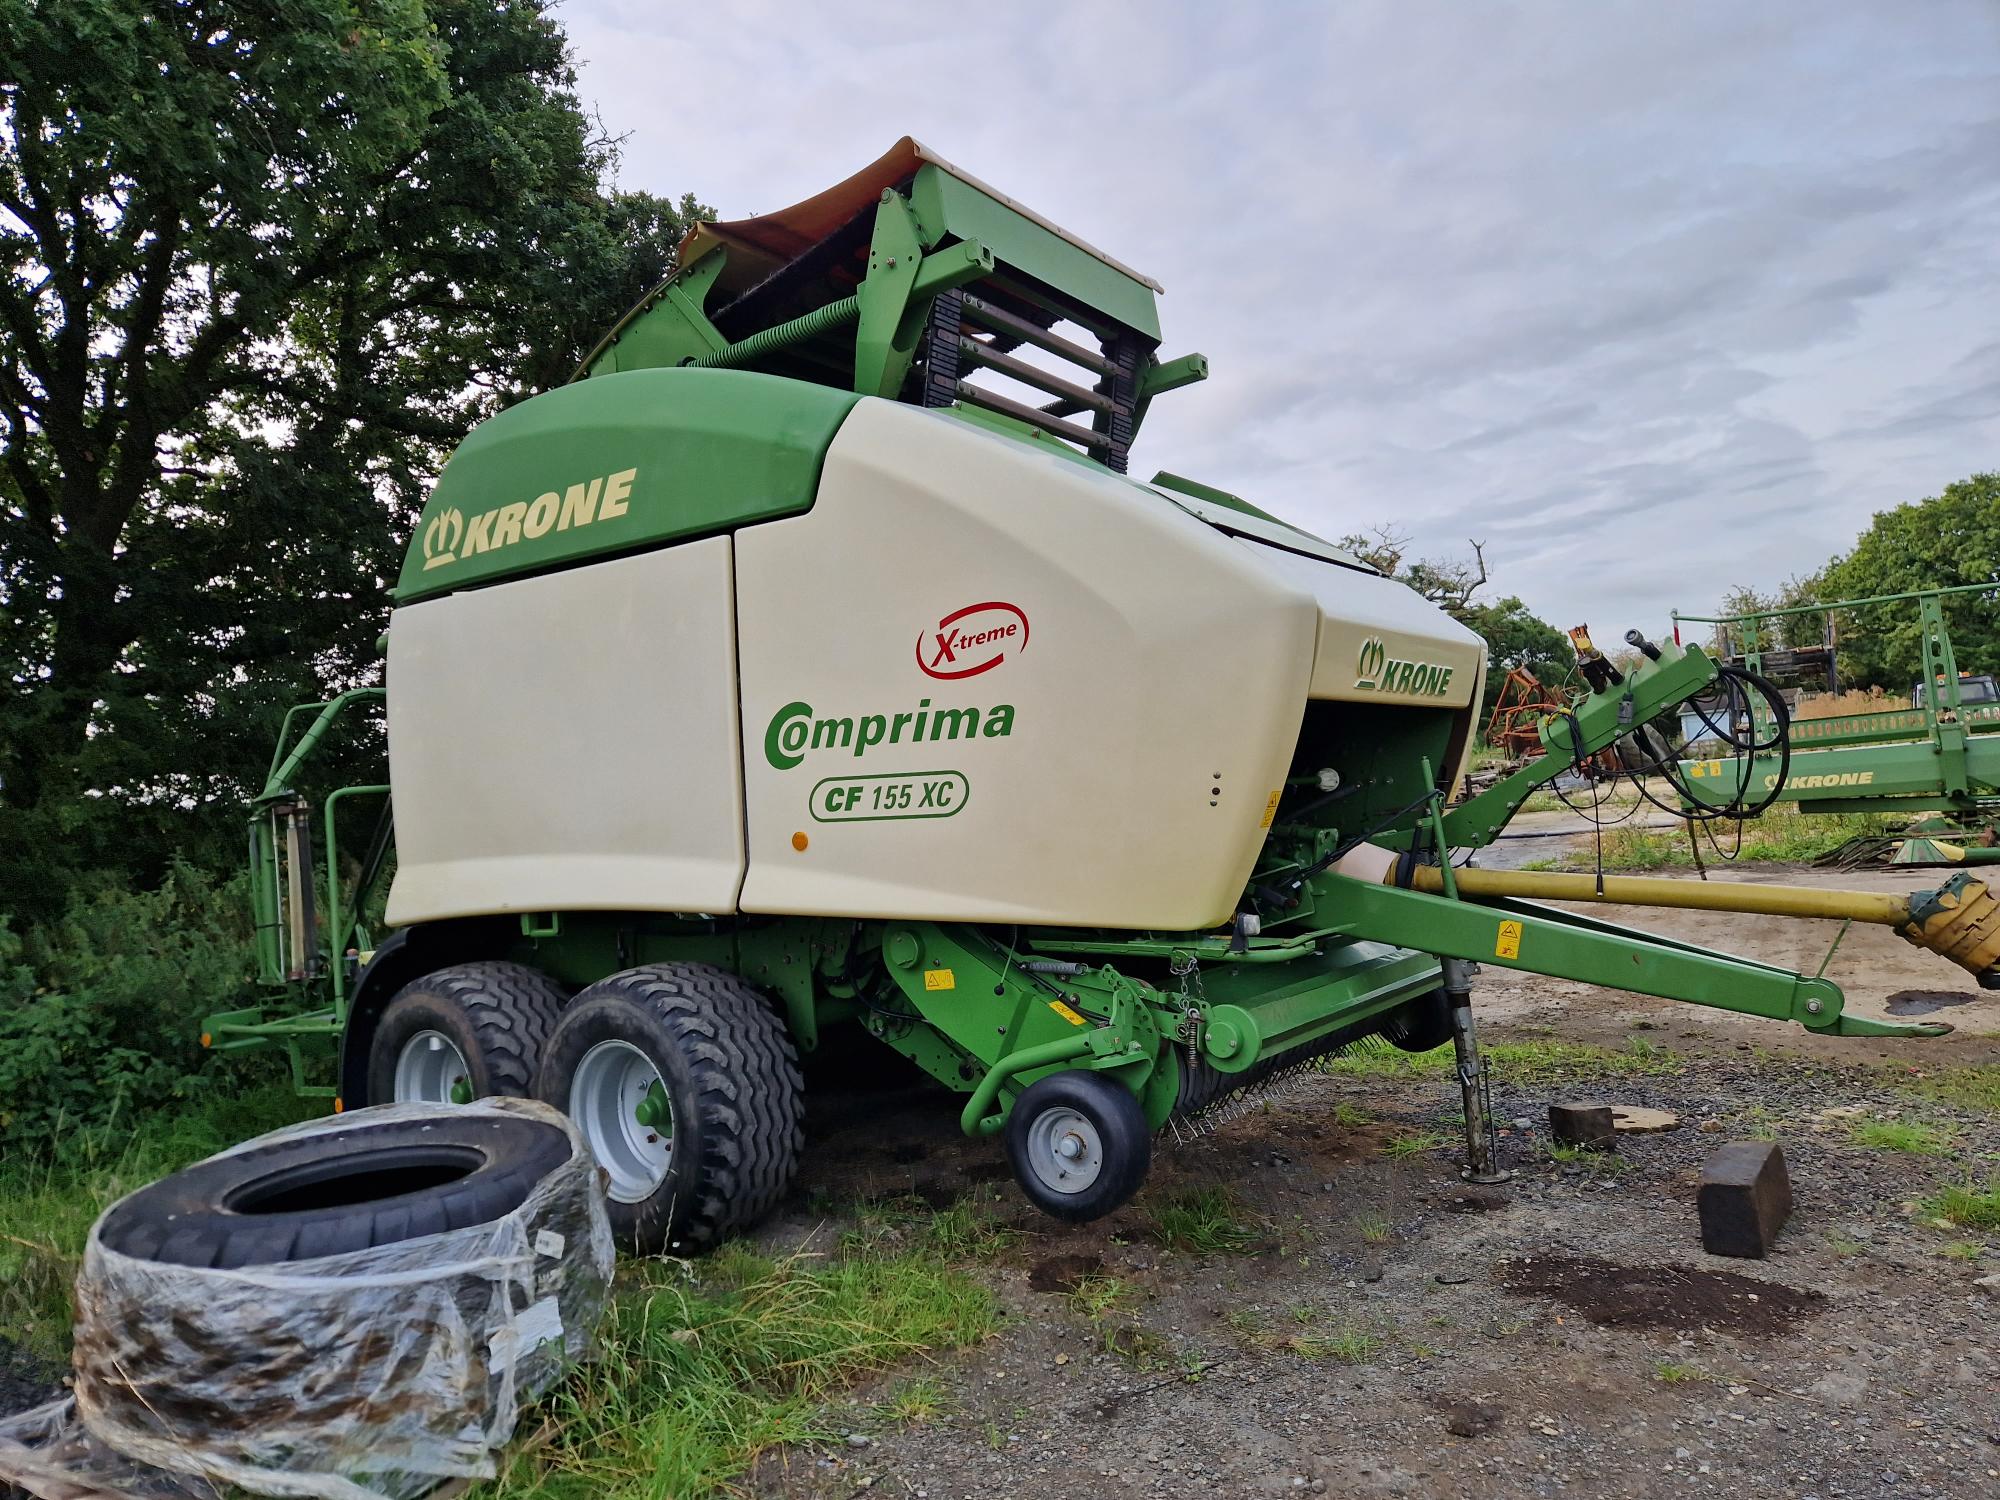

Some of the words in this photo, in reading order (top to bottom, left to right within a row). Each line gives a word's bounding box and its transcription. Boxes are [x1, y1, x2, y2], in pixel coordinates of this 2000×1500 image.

[460, 467, 637, 559] KRONE
[930, 623, 1017, 668] X-treme
[1378, 659, 1453, 697] KRONE
[764, 698, 1015, 771] Comprima
[824, 786, 863, 812] CF
[873, 784, 913, 810] 155
[918, 781, 954, 808] XC
[1789, 771, 1874, 789] KRONE
